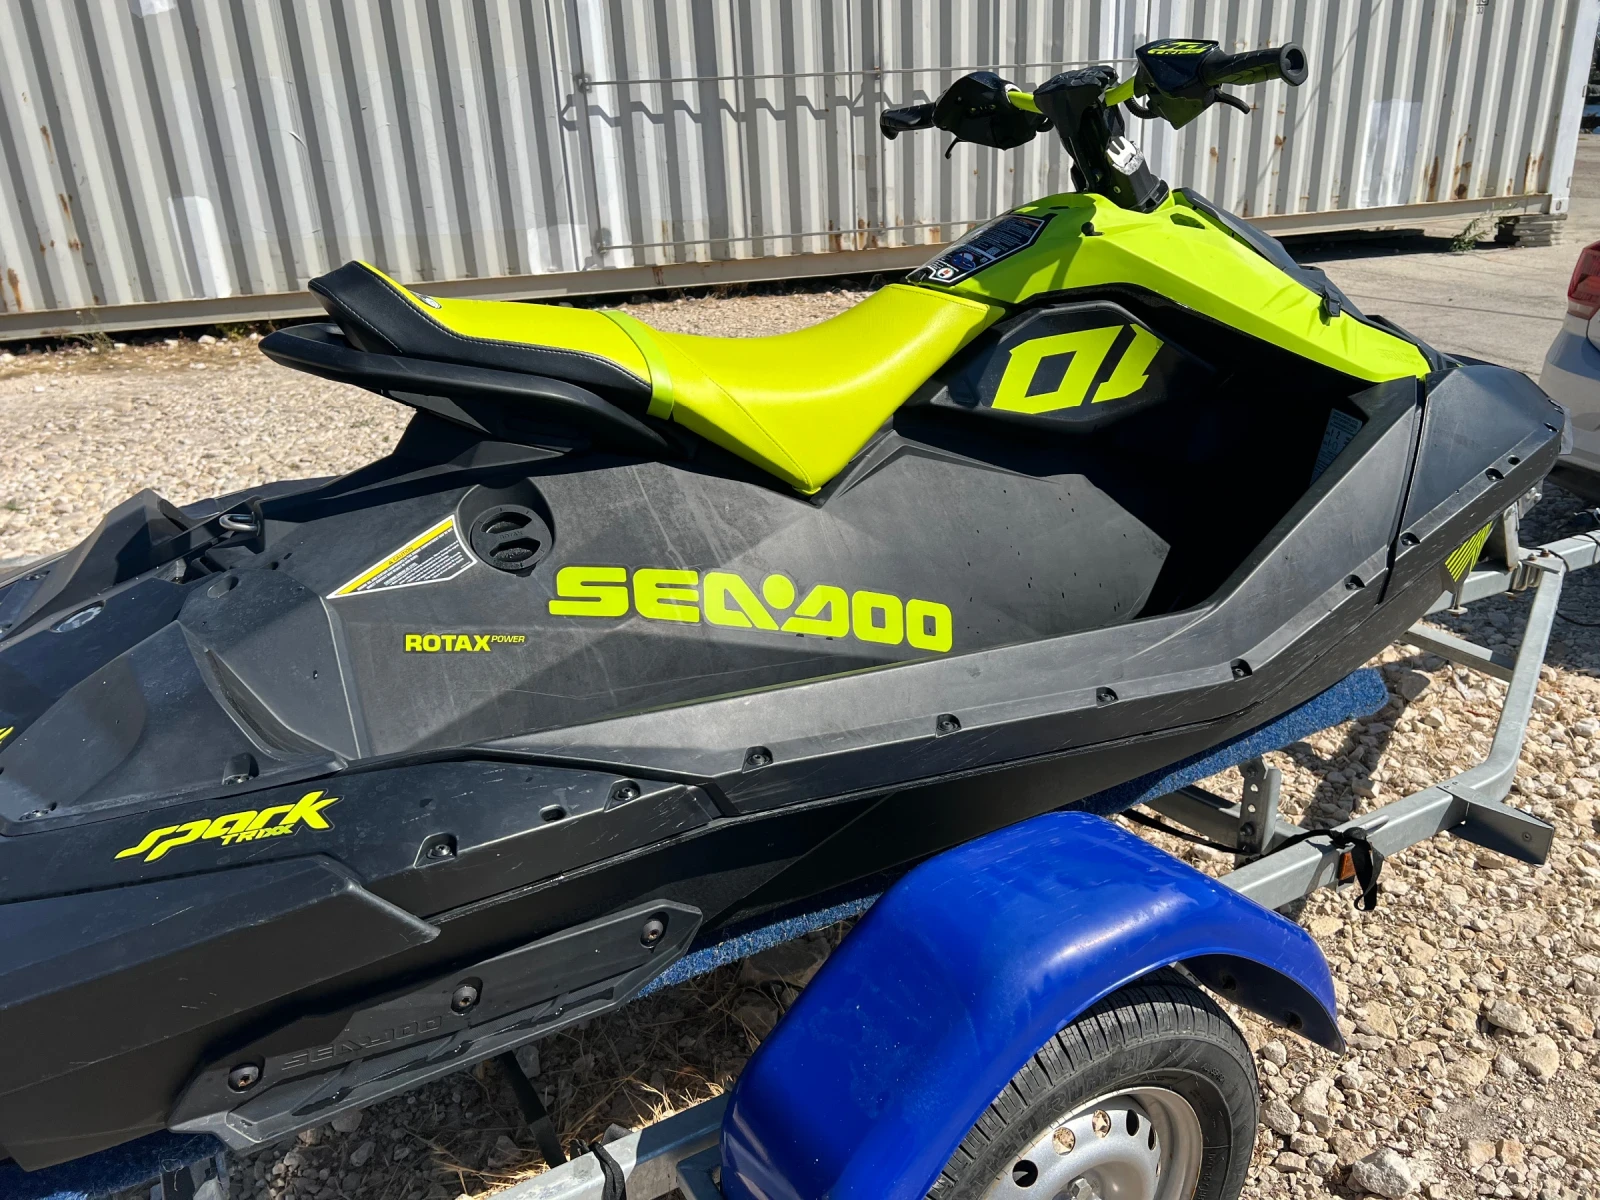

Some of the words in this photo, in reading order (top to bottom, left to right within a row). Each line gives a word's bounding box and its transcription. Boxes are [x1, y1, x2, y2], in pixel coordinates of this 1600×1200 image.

[405, 634, 491, 652] ROTAX
[491, 635, 526, 643] POWER
[221, 824, 295, 846] TRIXX
